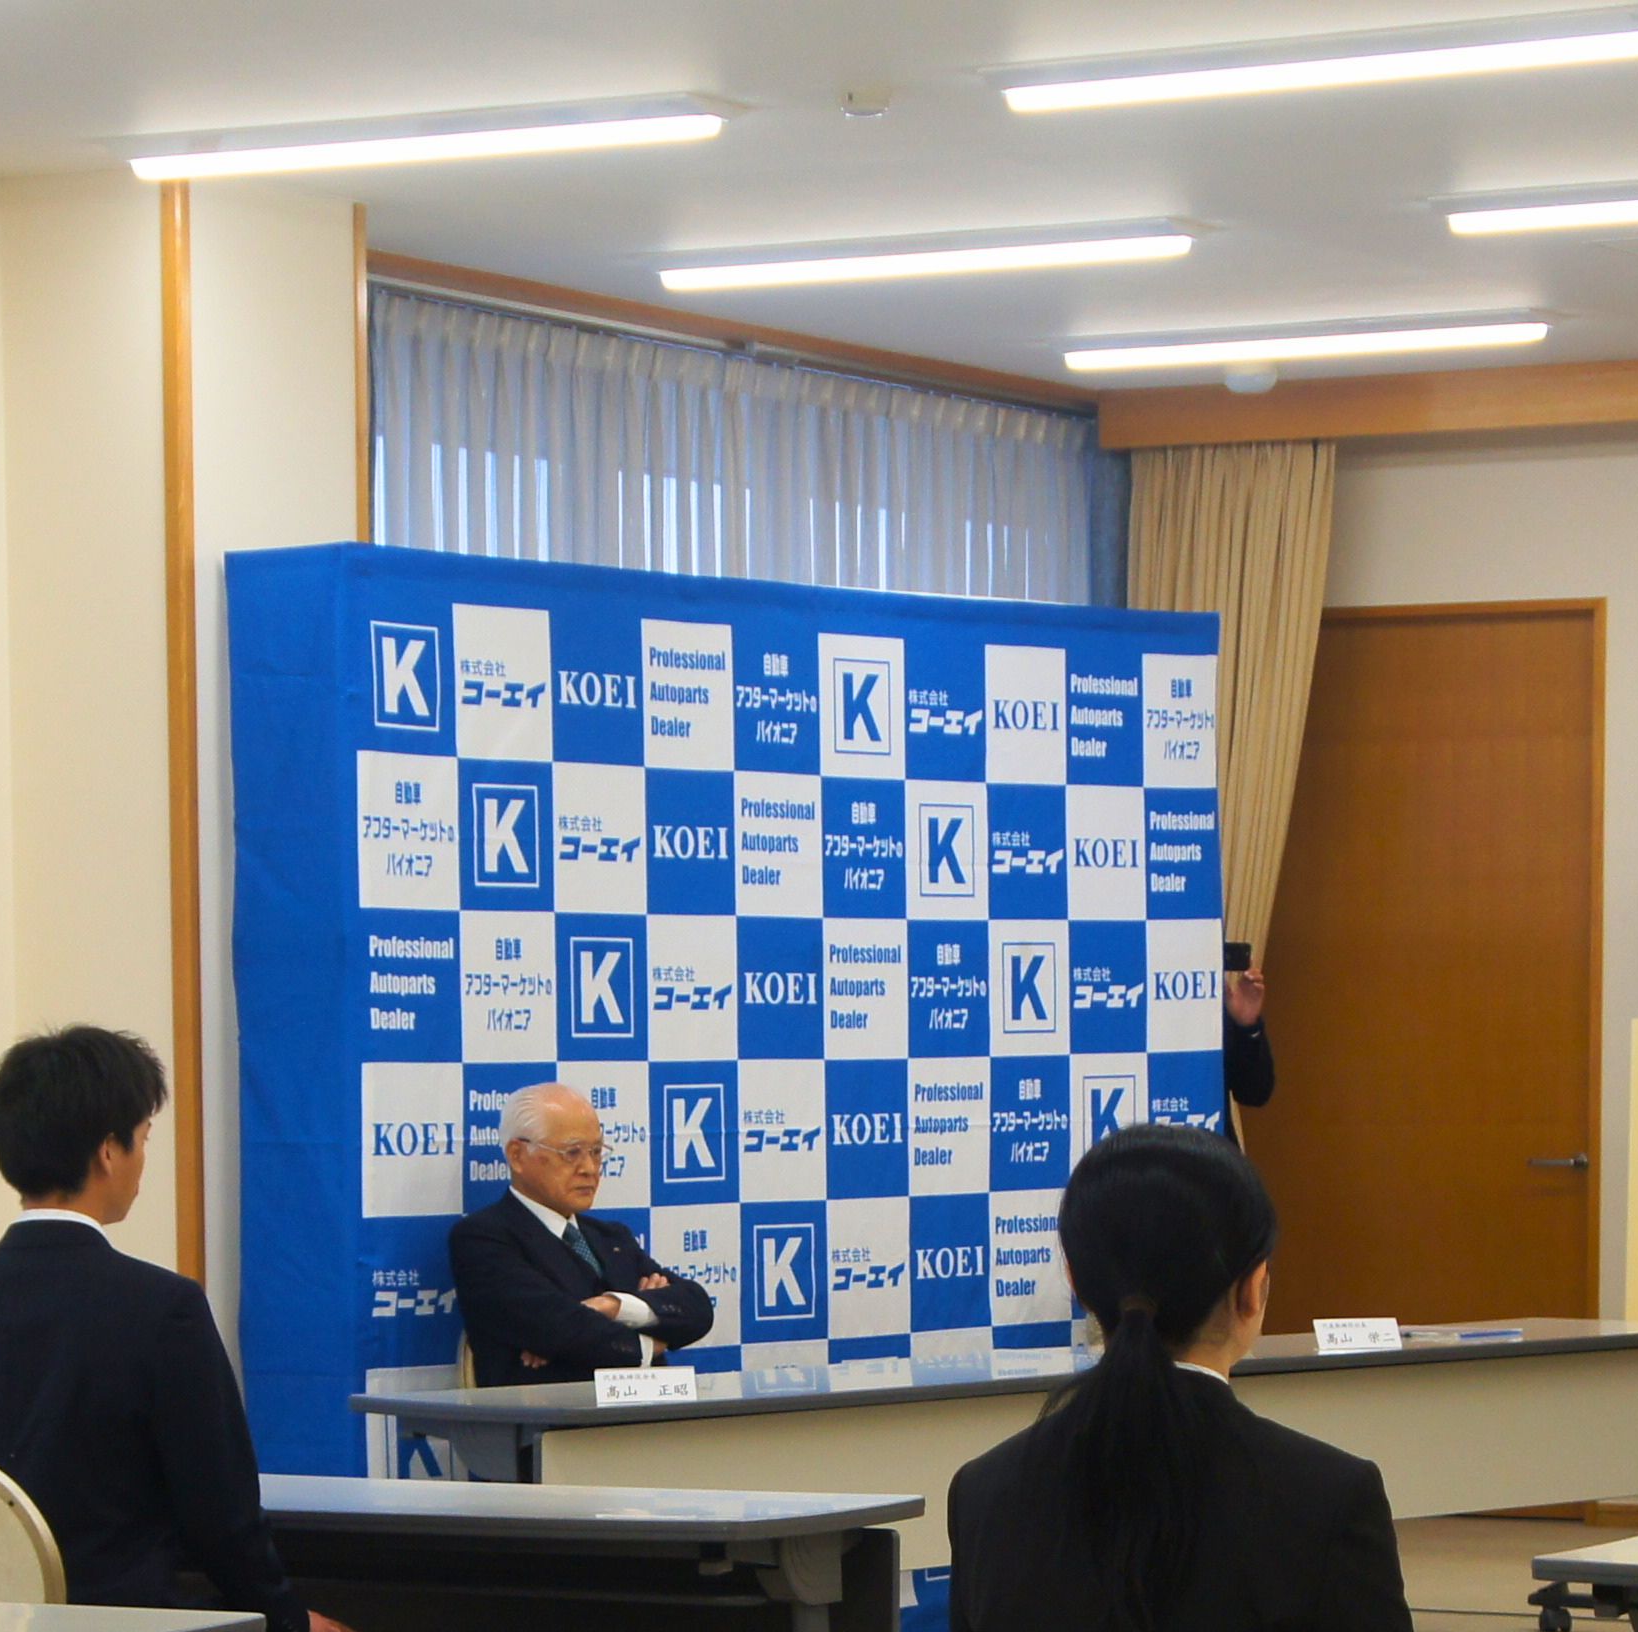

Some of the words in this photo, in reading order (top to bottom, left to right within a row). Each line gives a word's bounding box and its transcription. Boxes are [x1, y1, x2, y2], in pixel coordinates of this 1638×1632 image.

[460, 659, 506, 678] 株式会社
[649, 647, 726, 671] Professional
[763, 652, 789, 677] 自動車
[381, 636, 430, 717] K
[1070, 673, 1139, 697] Professional
[1170, 678, 1193, 699] 自動車
[461, 680, 546, 708] コーエイ
[558, 670, 637, 709] KOEI
[650, 681, 709, 705] Autoparts
[736, 685, 818, 713] アフターマーケットの
[908, 689, 948, 706] 株式会社
[842, 672, 882, 742] K
[994, 699, 1058, 731] KOEI
[1070, 705, 1124, 728] Autoparts
[651, 715, 691, 737] Dealer
[756, 719, 798, 745] パイオニア
[908, 708, 984, 735] コーエイ
[1071, 736, 1108, 758] Dealer
[1163, 740, 1201, 761] パイオニア
[395, 781, 422, 805] 自動車
[741, 798, 815, 820] Professional
[851, 801, 877, 825] 自動車
[1149, 810, 1215, 831] Professional
[363, 816, 455, 842] アフターマーケットの
[483, 798, 529, 874] K
[558, 815, 603, 833] 株式会社
[559, 836, 641, 862] コーエイ
[653, 825, 728, 860] KOEI
[741, 831, 799, 853] Autoparts
[824, 834, 904, 858] アフターマーケットの
[928, 817, 966, 884] K
[992, 831, 1030, 847] 株式会社
[991, 848, 1064, 874] コーエイ
[1075, 838, 1138, 868] KOEI
[1149, 842, 1202, 863] Autoparts
[386, 853, 433, 878] パイオニア
[742, 865, 781, 886] Dealer
[843, 867, 885, 891] パイオニア
[1150, 872, 1187, 893] Dealer
[369, 934, 454, 959] Professional
[495, 938, 522, 961] 自動車
[829, 944, 901, 964] Professional
[936, 943, 961, 966] 自動車
[369, 971, 436, 997] Autoparts
[465, 973, 551, 996] アフターマーケットの
[653, 966, 696, 983] 株式会社
[1073, 967, 1111, 982] 株式会社
[1155, 971, 1216, 1001] KOEI
[580, 950, 624, 1024] K
[653, 984, 733, 1011] コーエイ
[744, 971, 817, 1005] KOEI
[829, 977, 886, 998] Autoparts
[910, 976, 987, 998] アフターマーケットの
[1011, 955, 1048, 1021] K
[1073, 982, 1145, 1009] コーエイ
[370, 1007, 416, 1030] Dealer
[487, 1008, 532, 1031] パイオニア
[830, 1010, 868, 1029] Dealer
[928, 1007, 969, 1030] パイオニア
[591, 1087, 617, 1110] 自動車
[914, 1082, 984, 1102] Professional
[1018, 1078, 1042, 1101] 自動車
[1091, 1087, 1126, 1142] K
[1152, 1097, 1189, 1112] 株式会社
[743, 1109, 785, 1125] 株式会社
[832, 1112, 903, 1146] KOEI
[914, 1116, 969, 1135] Autoparts
[992, 1109, 1068, 1133] アフターマーケットの
[373, 1122, 455, 1157] KOEI
[469, 1125, 503, 1147] Auto
[672, 1097, 716, 1169] K
[743, 1127, 821, 1153] コーエイ
[914, 1147, 953, 1166] Dealer
[1010, 1140, 1050, 1163] パイオニア
[995, 1214, 1060, 1234] Profession
[683, 1229, 708, 1253] 自動車
[832, 1247, 871, 1263] 株式会社
[915, 1245, 984, 1280] KOEI
[995, 1246, 1051, 1266] Autoparts
[372, 1269, 420, 1287] 株式会社
[762, 1236, 806, 1307] K
[832, 1262, 905, 1292] コーエイ
[995, 1277, 1036, 1297] Dealer
[371, 1289, 457, 1318] コーエイ
